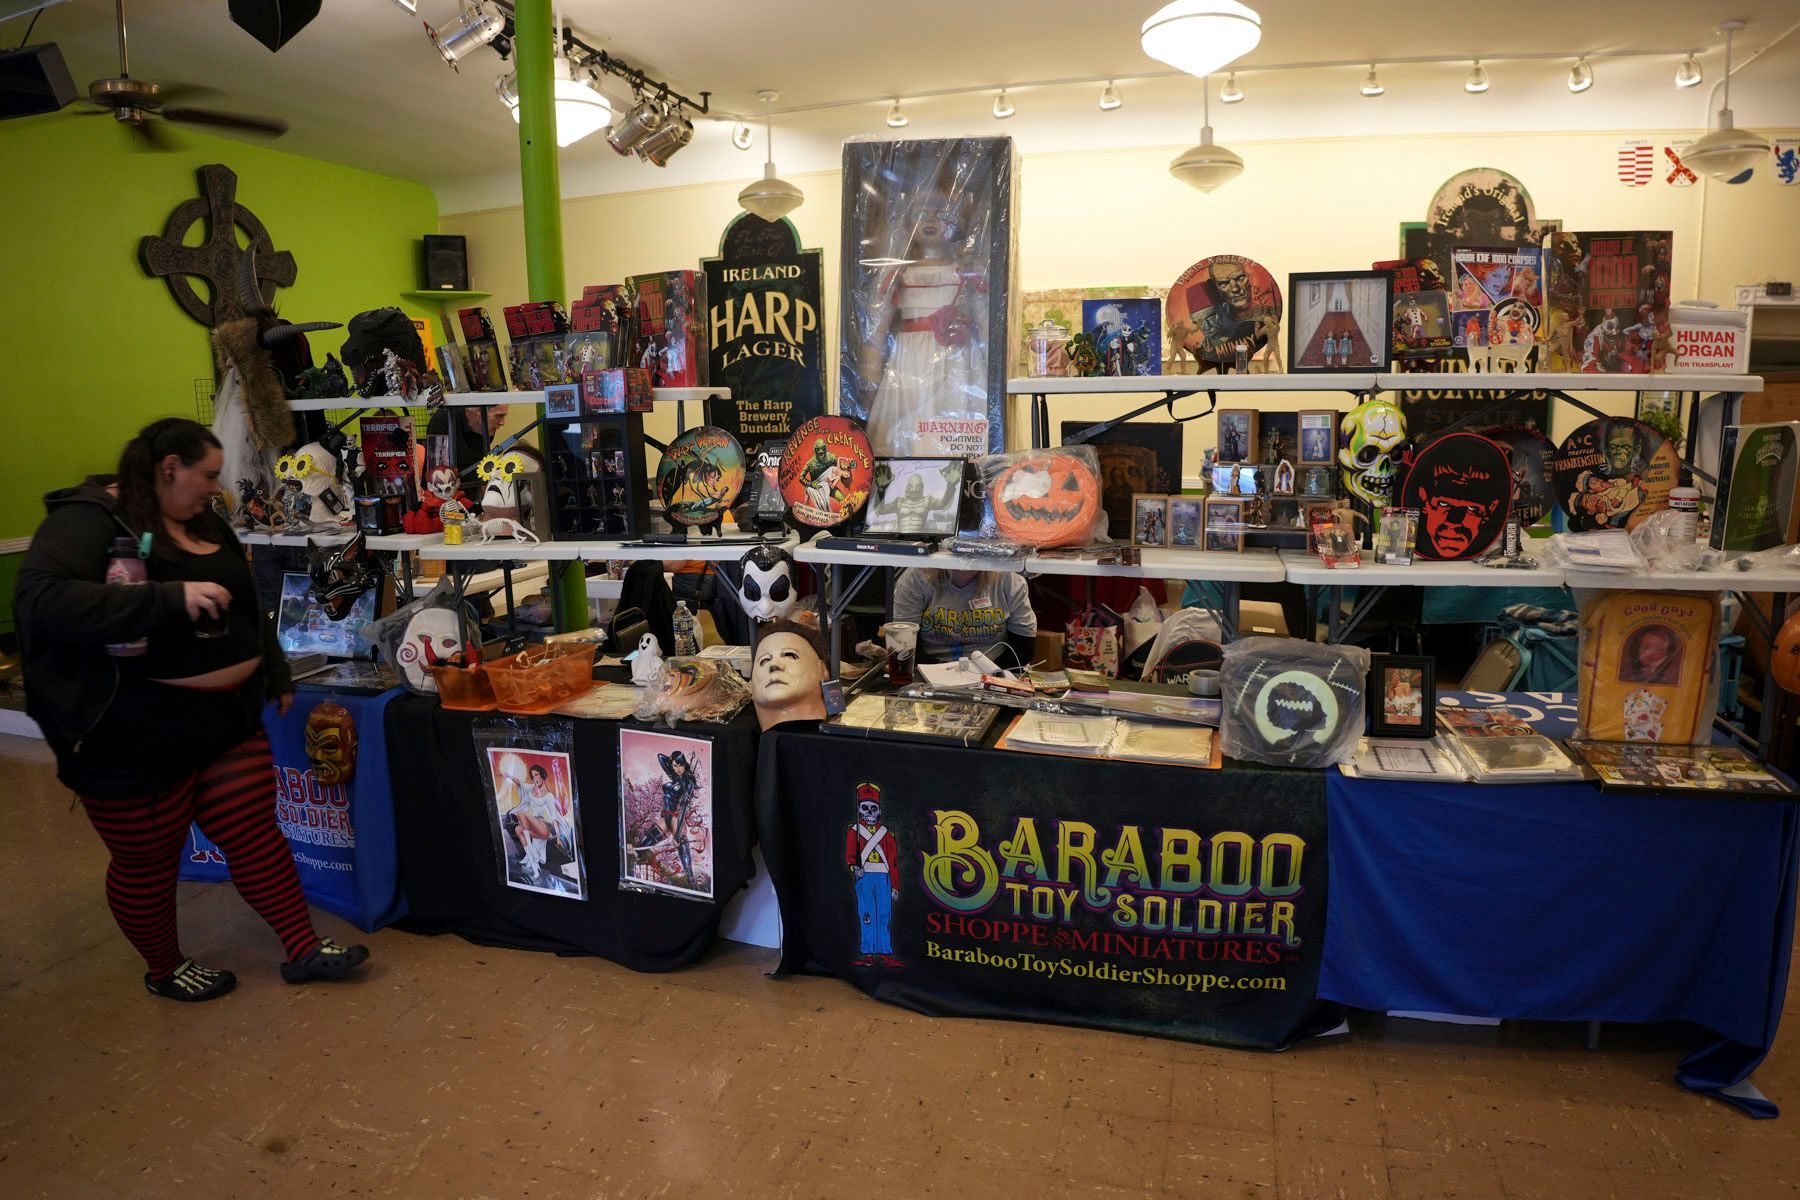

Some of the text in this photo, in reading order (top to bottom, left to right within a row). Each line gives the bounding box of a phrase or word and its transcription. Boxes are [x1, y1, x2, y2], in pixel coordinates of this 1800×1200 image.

[1455, 253, 1536, 265] HOUSE OF 1000 CORPSES
[723, 264, 801, 283] IRELAND
[1589, 256, 1638, 289] 1000
[710, 290, 816, 352] HARP
[1676, 330, 1735, 344] HUMAN
[721, 340, 807, 371] LAGER
[1676, 344, 1735, 358] ORGAN
[736, 400, 793, 412] The Harp
[739, 412, 790, 424] Brewery,
[740, 423, 791, 434] Dundalk
[941, 435, 984, 443] POSITIVELY
[783, 416, 820, 465] REVENGE
[826, 431, 870, 470] CREATURE
[950, 443, 963, 451] DO
[1554, 453, 1606, 472] FRANKENSTEIN
[922, 604, 1006, 633] BARABOO
[1624, 602, 1694, 617] Good Guys
[274, 765, 349, 809] ABOO
[277, 803, 353, 838] SOLDIER
[921, 808, 1308, 914] BARABOO
[1005, 882, 1302, 947] TOY SOLDIER
[925, 910, 1048, 951] SHOPPE
[1070, 927, 1281, 968] MINIATURES
[925, 940, 1287, 993] BarabooToySoldierShoppe.com
